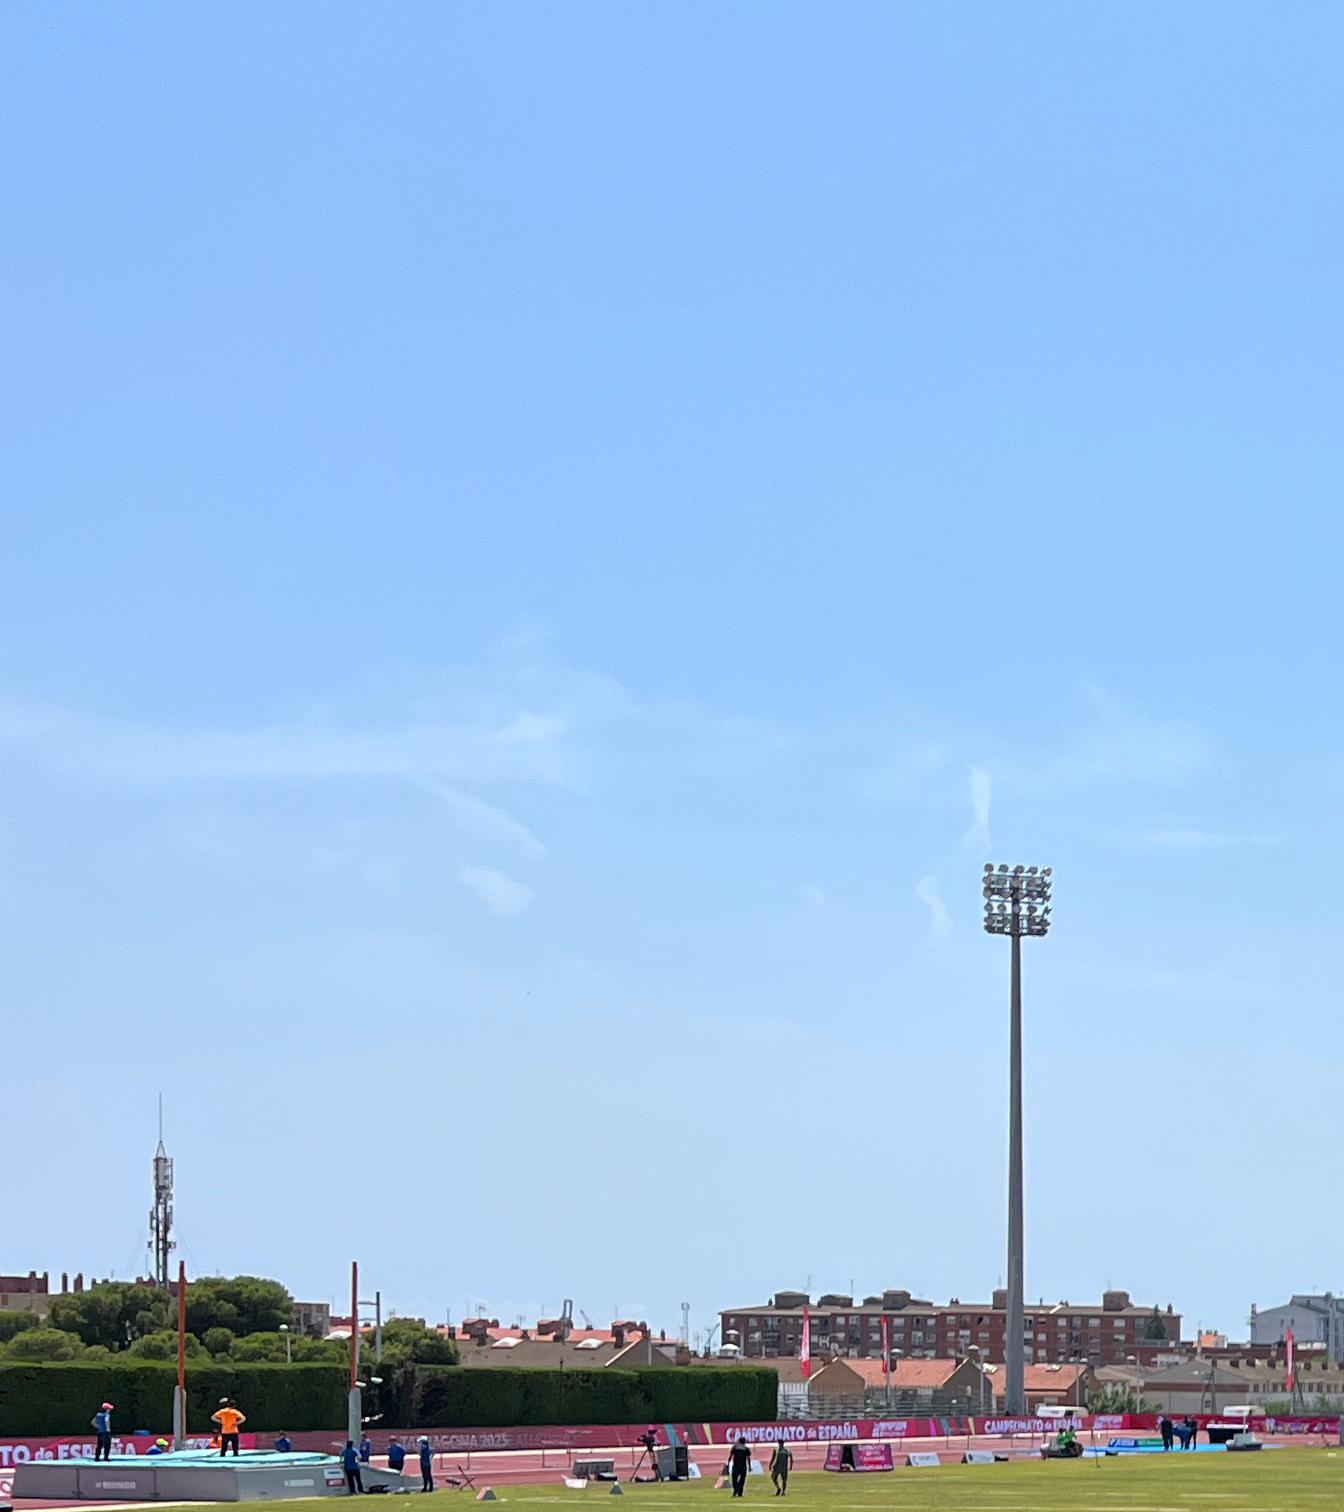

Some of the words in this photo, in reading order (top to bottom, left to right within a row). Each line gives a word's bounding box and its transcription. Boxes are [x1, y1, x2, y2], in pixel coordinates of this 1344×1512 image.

[725, 1425, 805, 1443] CAMPEONATO
[818, 1421, 859, 1440] ESPAÑA
[34, 1447, 54, 1461] de
